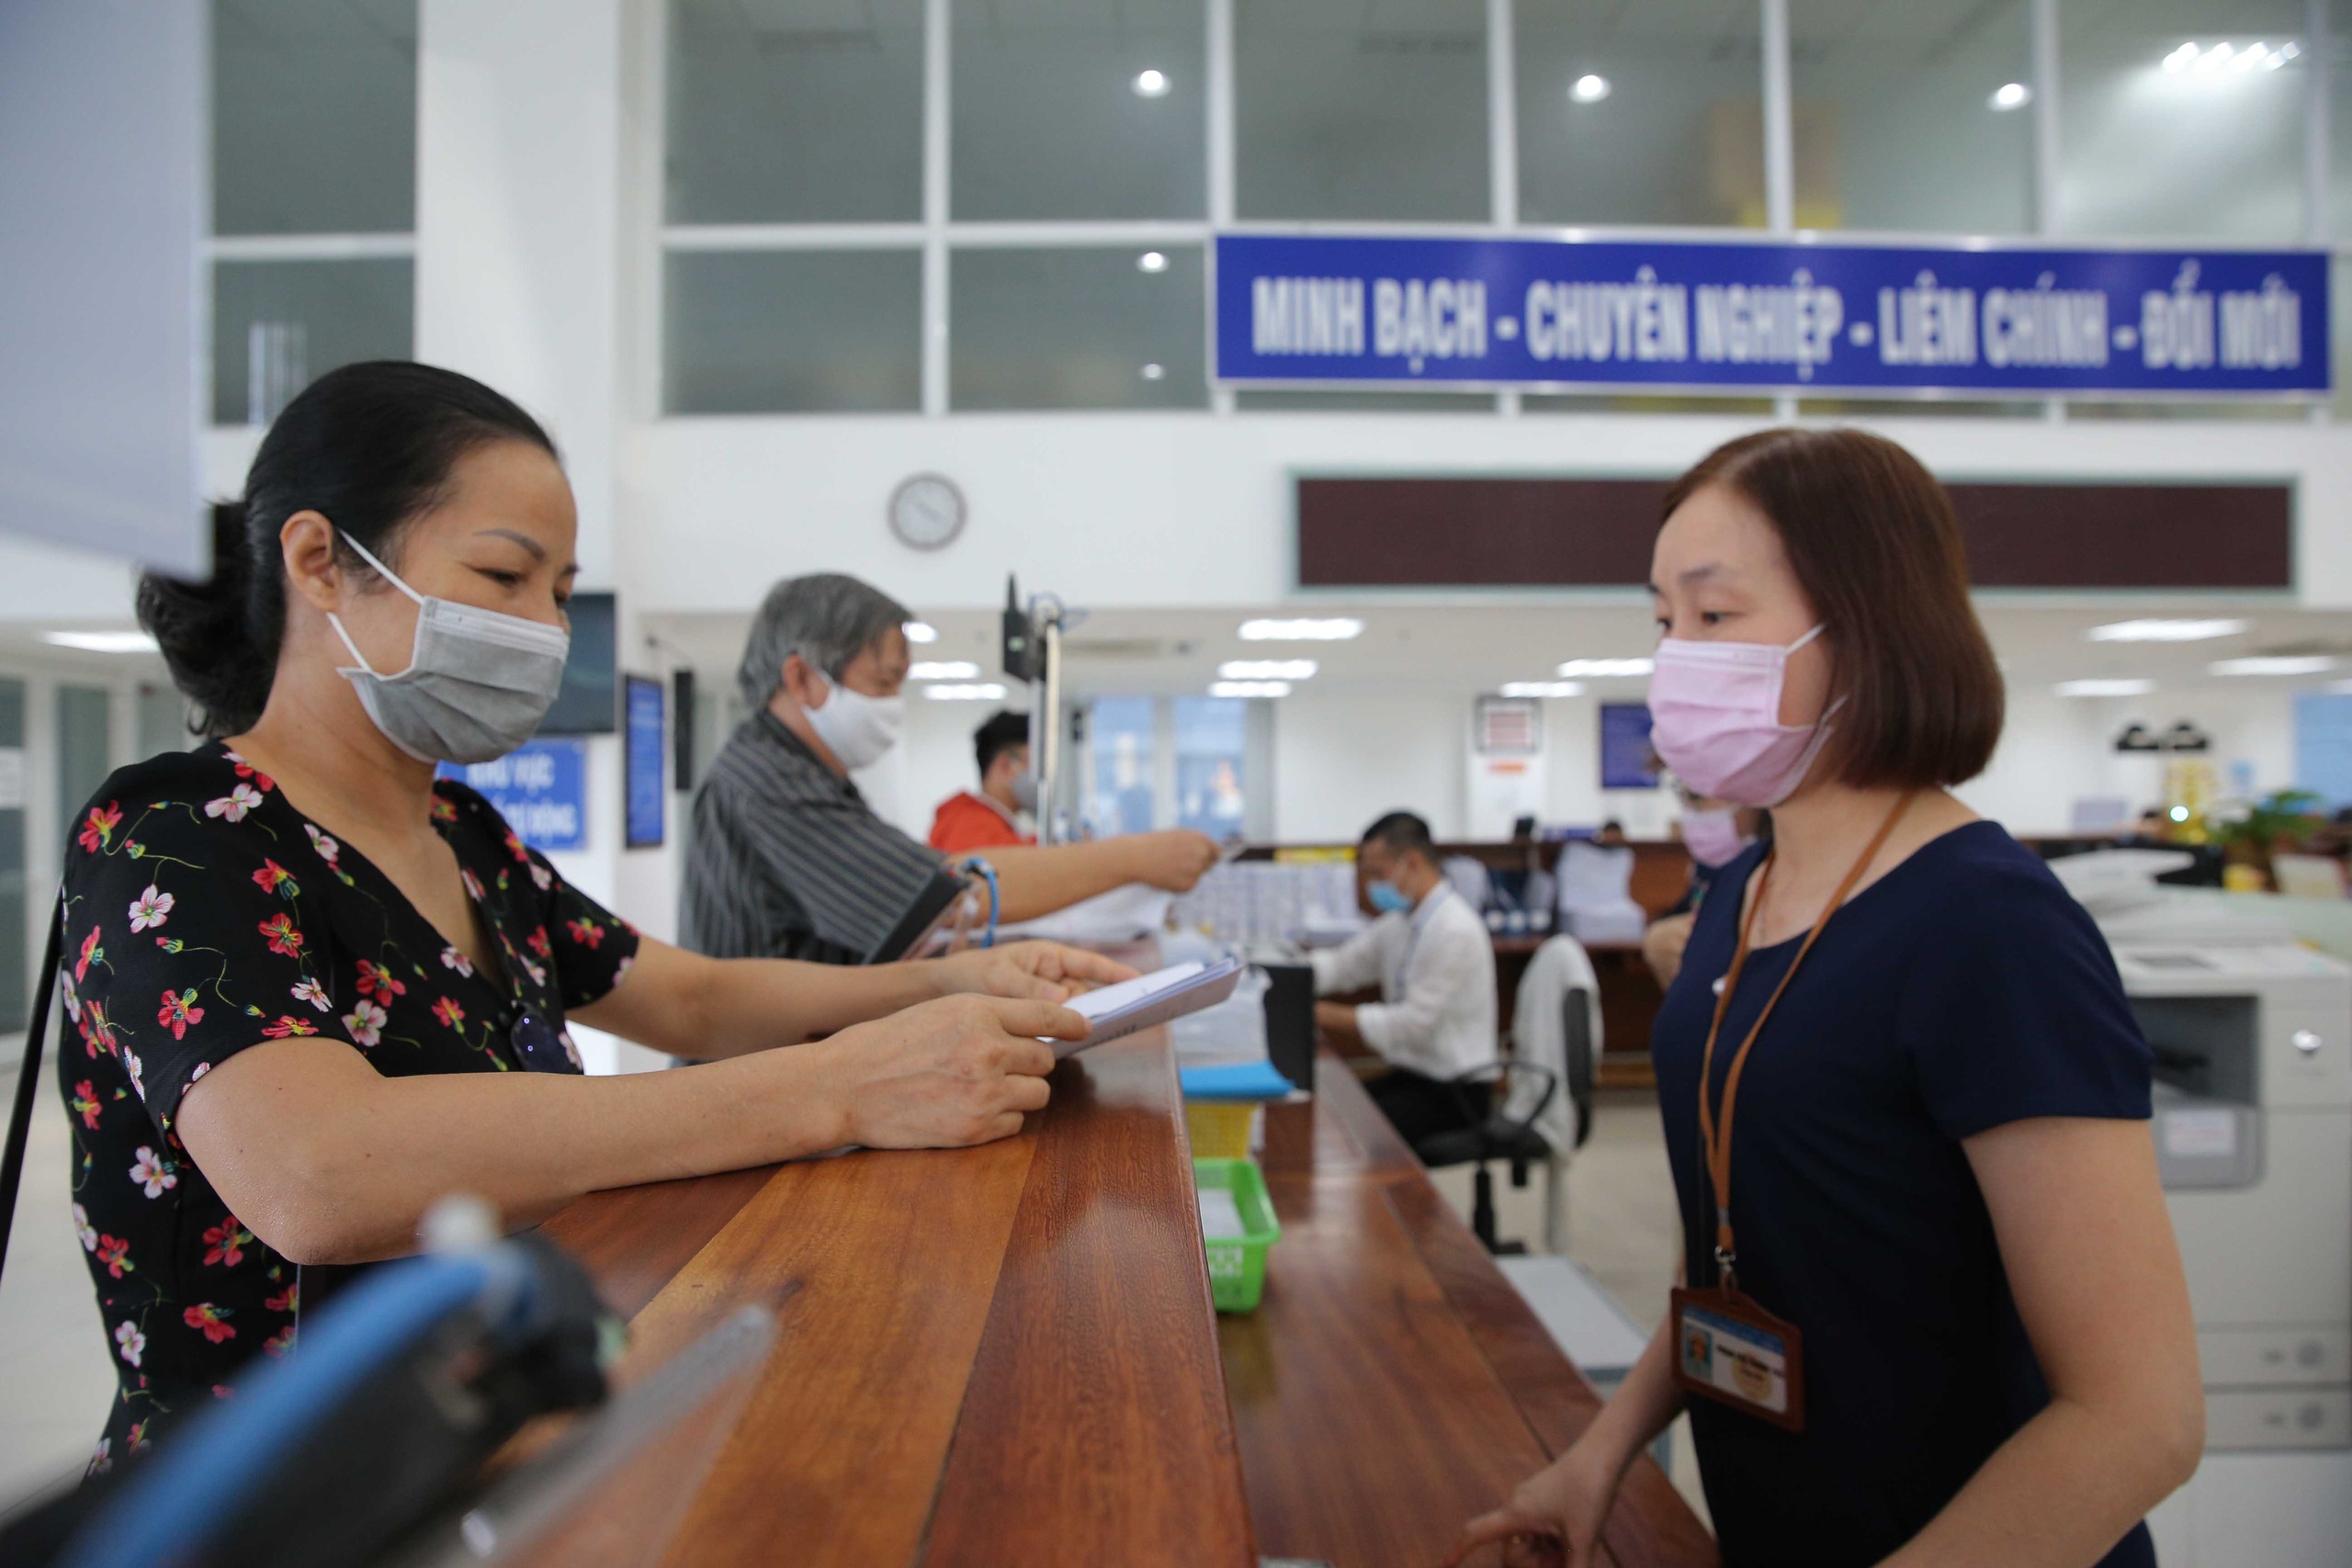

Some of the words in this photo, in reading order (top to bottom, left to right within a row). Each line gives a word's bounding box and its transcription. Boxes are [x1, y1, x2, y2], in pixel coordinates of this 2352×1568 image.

[1252, 276, 1365, 355] MINH
[1374, 277, 1487, 374] BẠCH
[1525, 265, 1689, 361] CHUYÊN
[1695, 267, 1844, 380] NGHIỆP
[1879, 270, 1977, 365] LIÊM
[1983, 272, 2109, 367] CHÍNH
